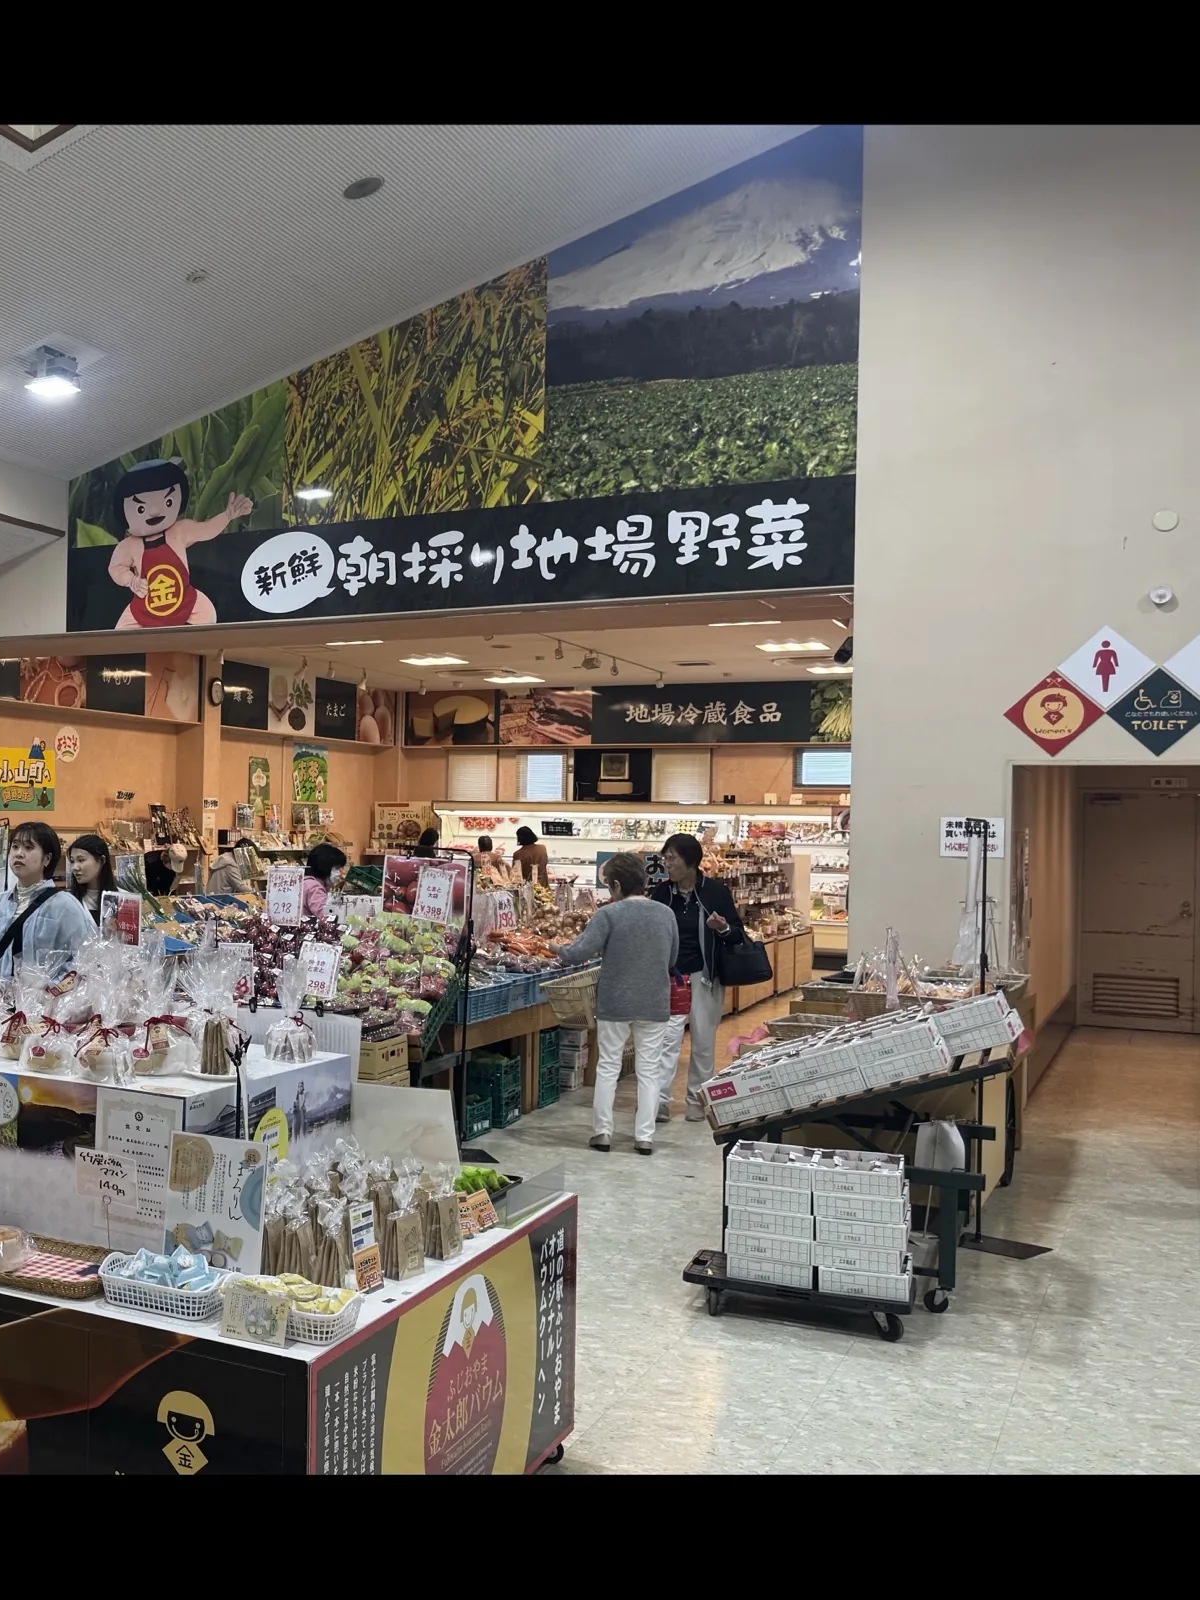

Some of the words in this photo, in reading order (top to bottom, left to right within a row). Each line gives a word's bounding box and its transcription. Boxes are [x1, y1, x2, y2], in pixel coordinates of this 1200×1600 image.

[336, 498, 809, 596] 朝採り地場野菜
[254, 546, 324, 597] 新鮮
[147, 572, 180, 609] 金
[325, 703, 346, 717] たまご
[625, 700, 781, 726] 地場冷蔵食品
[1131, 720, 1188, 730] TOILET
[56, 735, 78, 752] ようこそ
[273, 902, 292, 914] 298
[420, 905, 442, 916] ¥398
[307, 979, 326, 989] 298
[100, 1167, 128, 1179] マフィン
[100, 1180, 126, 1197] 140円
[546, 1234, 557, 1359] オリジナル
[538, 1238, 549, 1414] バウムクーヘン
[553, 1227, 565, 1425] 道の駅ふじおやま
[447, 1353, 488, 1401] ふじおやま
[429, 1370, 503, 1454] 金太郎バウム
[176, 1444, 194, 1469] 金
